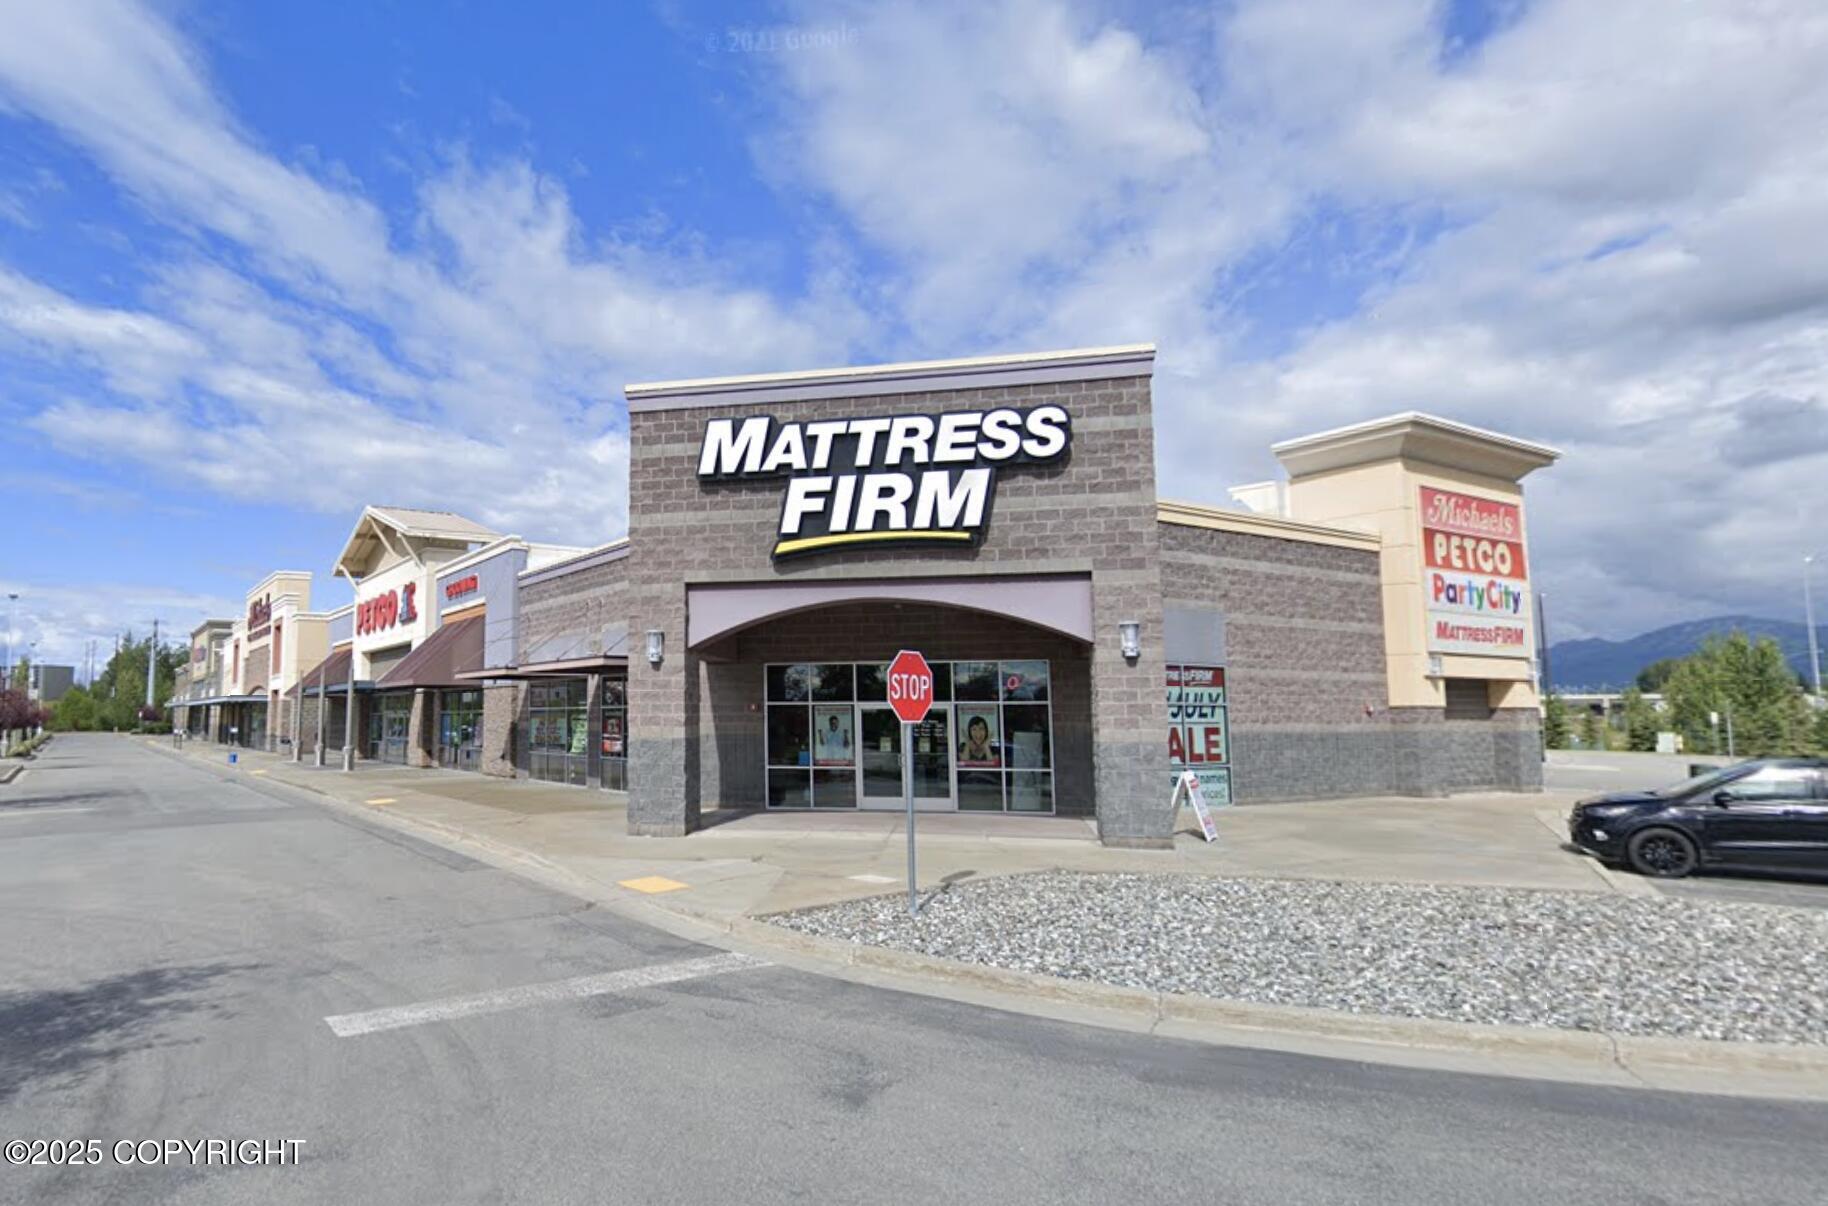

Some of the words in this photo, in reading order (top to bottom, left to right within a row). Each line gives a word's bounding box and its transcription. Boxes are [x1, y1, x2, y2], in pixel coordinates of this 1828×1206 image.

[699, 405, 1068, 476] MATTRESS
[780, 468, 992, 534] FIRM
[1427, 494, 1515, 535] Michaels
[1433, 532, 1512, 576] PETCO
[356, 589, 398, 636] PETCO
[890, 673, 930, 700] STOP
[1170, 691, 1221, 719] JULY
[1167, 726, 1222, 763] ALE
